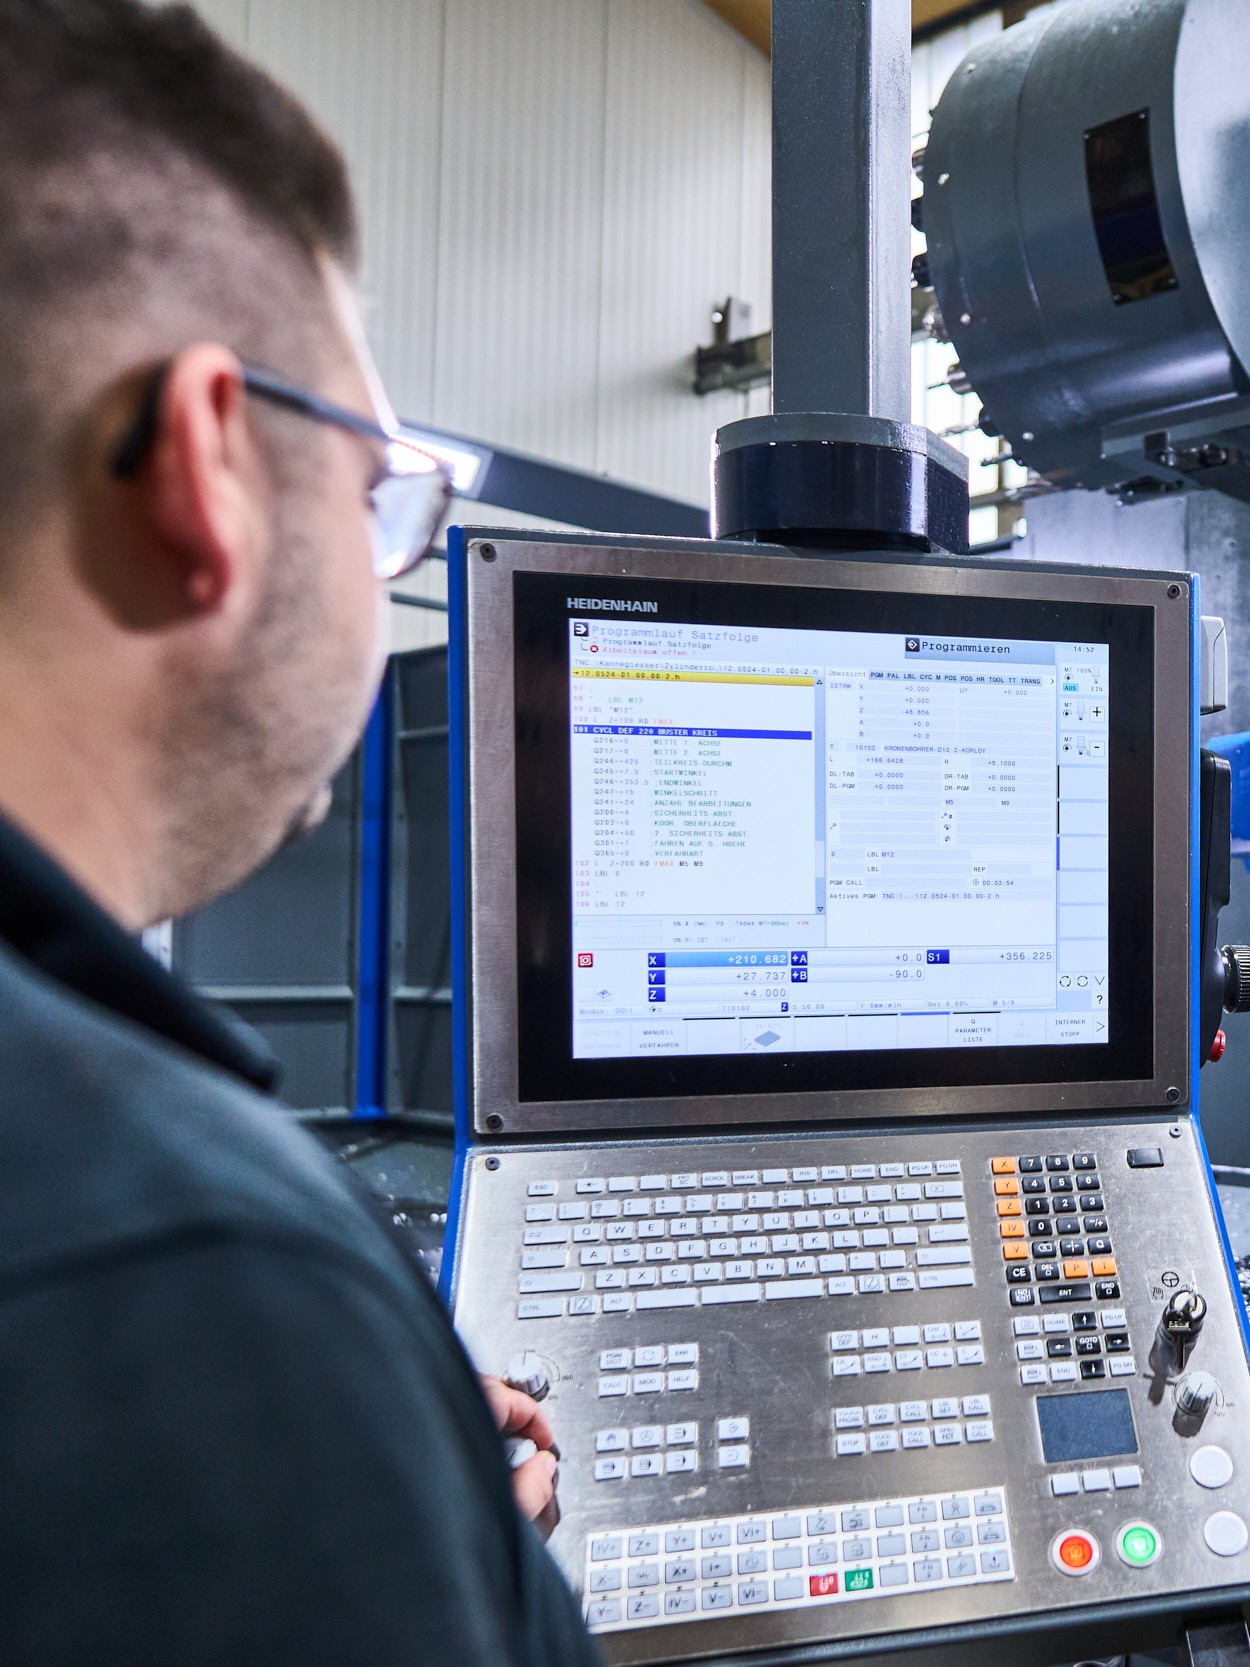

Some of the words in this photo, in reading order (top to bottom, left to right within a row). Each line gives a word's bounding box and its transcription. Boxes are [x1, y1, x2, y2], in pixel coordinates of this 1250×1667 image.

[567, 597, 658, 613] HEIDENHAIN
[591, 625, 683, 640] Programmlauf
[691, 630, 758, 643] Satzfolge
[921, 642, 1009, 653] Programmieren
[727, 954, 786, 964] +210.682
[895, 952, 922, 962] +0.0
[928, 952, 940, 961] S1
[999, 951, 1051, 960] +356.225
[736, 971, 786, 980] +27.737
[889, 969, 922, 978] -90.0
[743, 988, 786, 997] +4.000
[1013, 1268, 1026, 1277] CE
